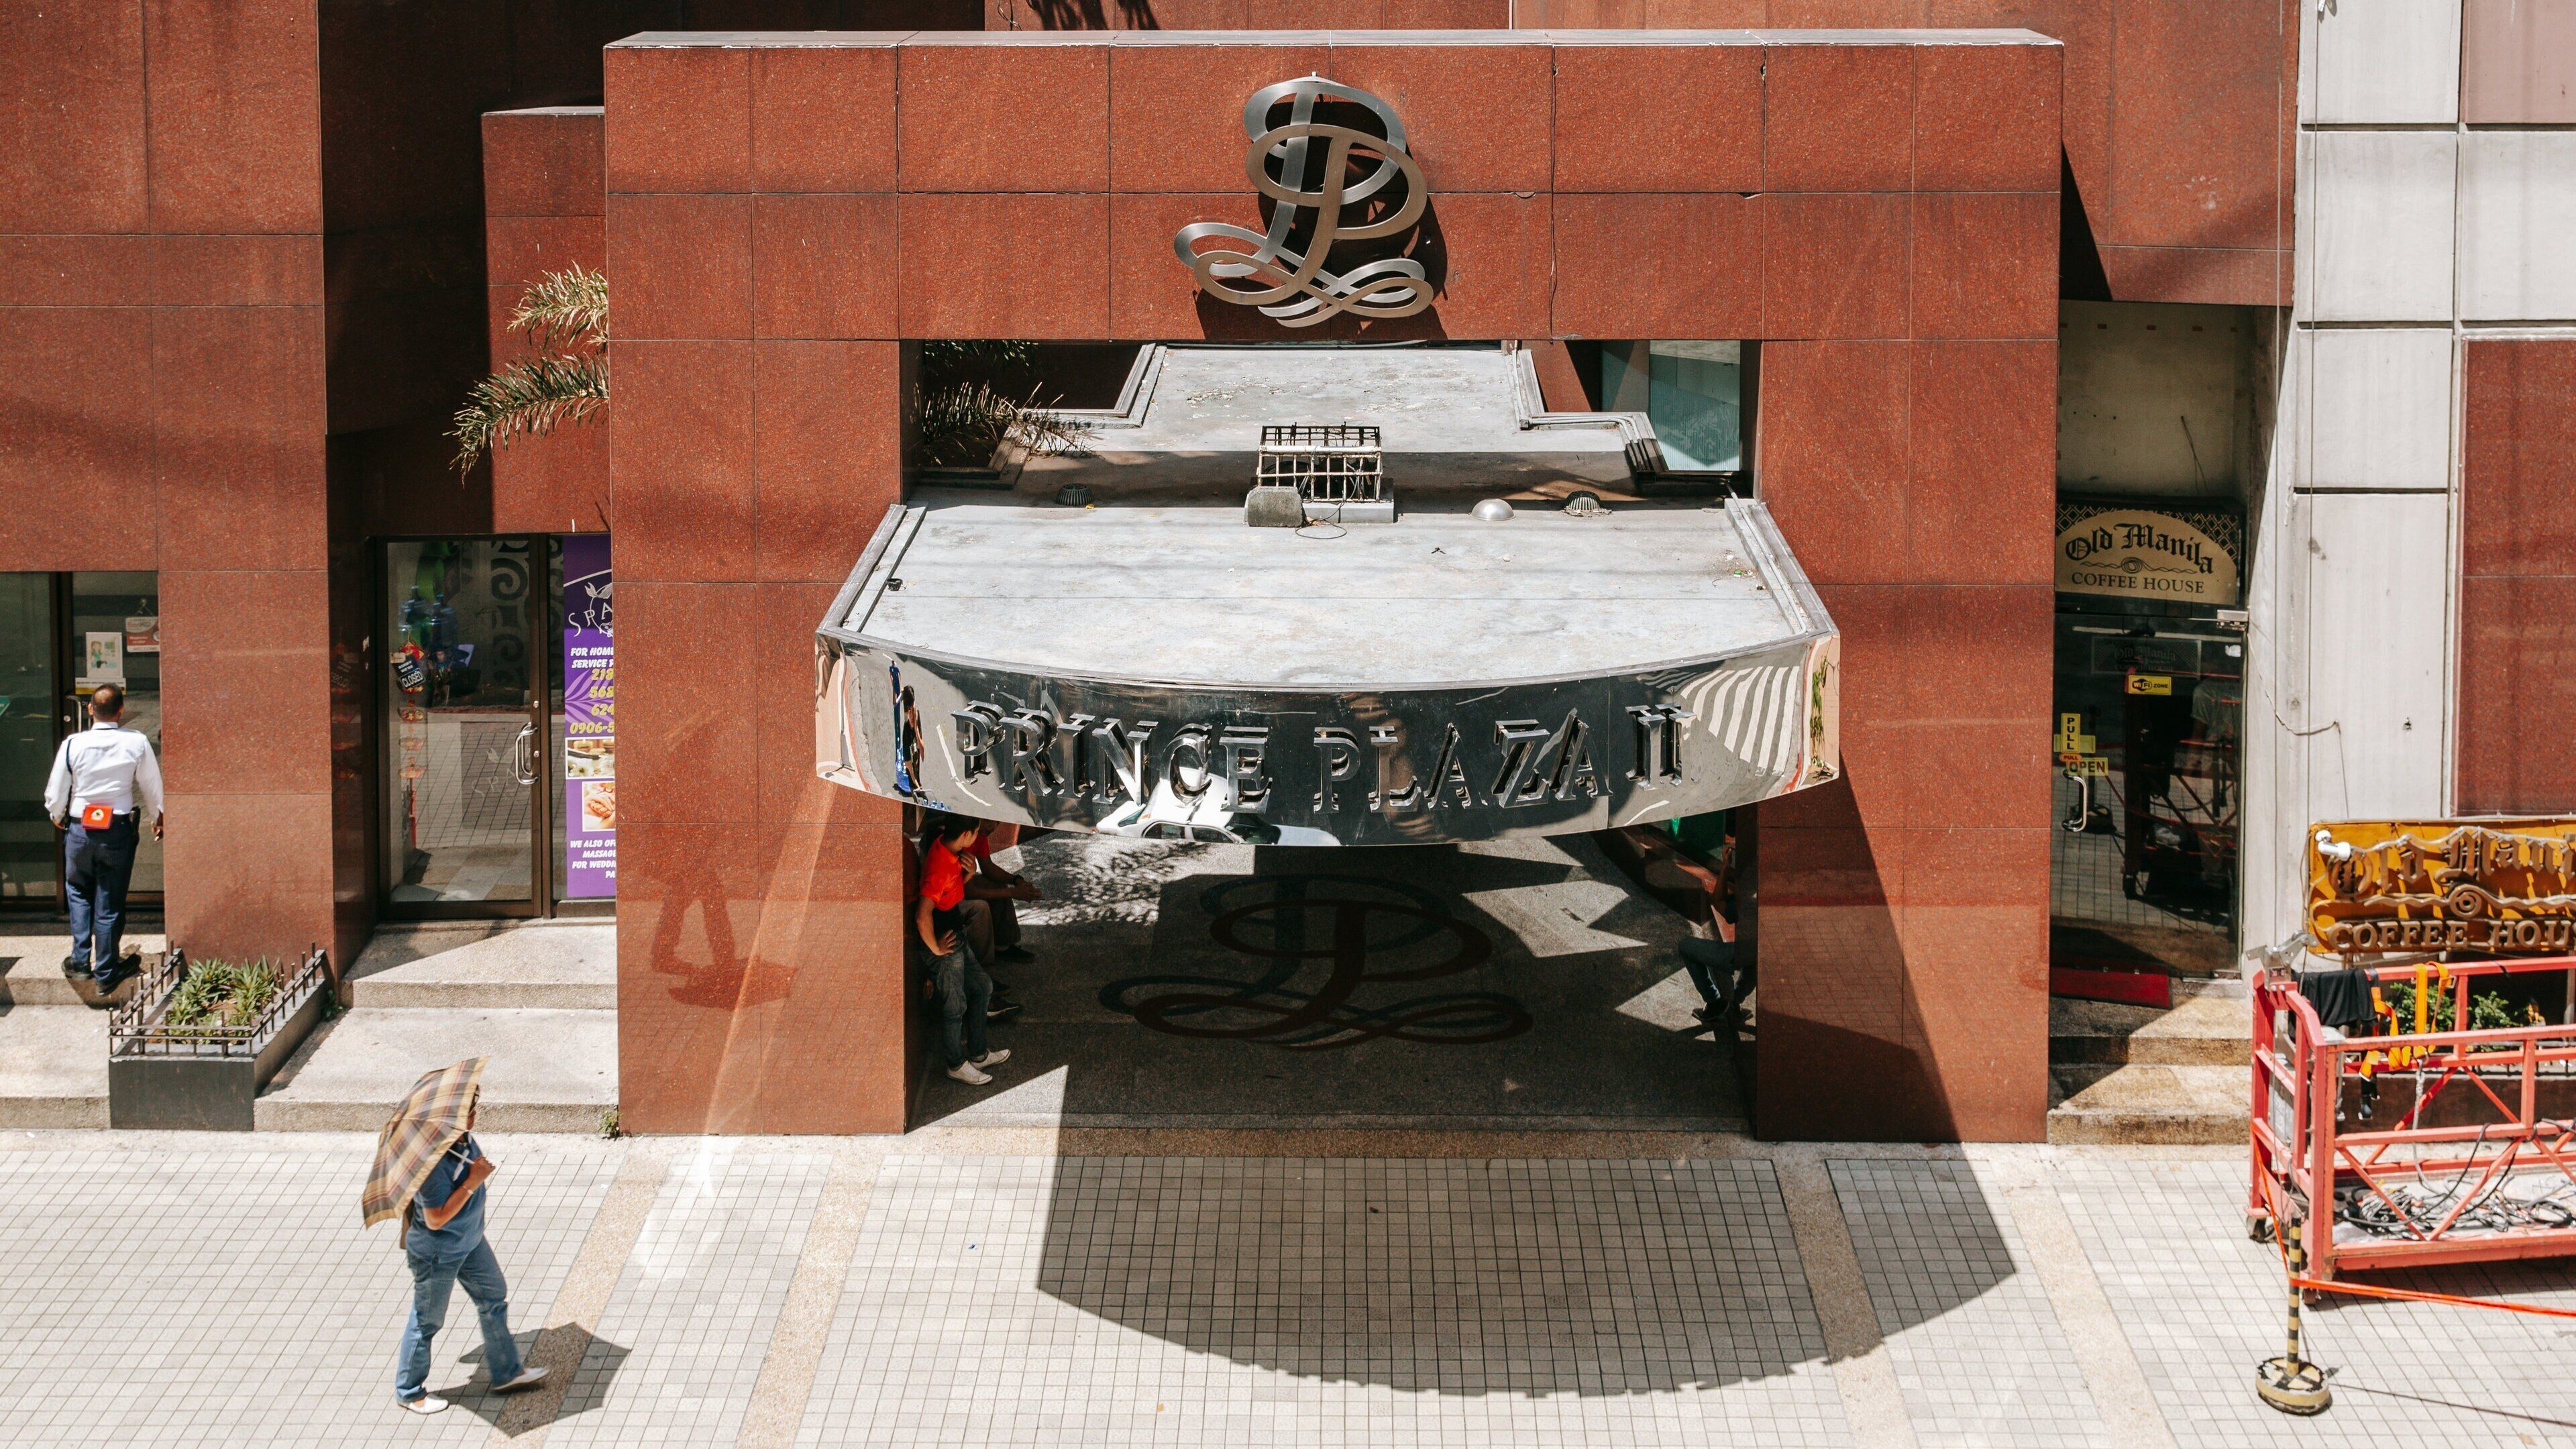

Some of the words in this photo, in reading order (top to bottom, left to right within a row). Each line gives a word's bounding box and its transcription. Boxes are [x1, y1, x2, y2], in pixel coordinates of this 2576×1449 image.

[2065, 527, 2113, 561] Old
[2114, 523, 2213, 574] Manila
[2072, 572, 2137, 588] COFFEE
[2143, 577, 2204, 594] HOUSE
[570, 647, 588, 656] FOR
[572, 659, 607, 668] SERVICE
[402, 671, 423, 688] CLOSED
[2067, 717, 2075, 750] PULL
[951, 701, 1272, 814] PRINCE
[1313, 708, 1613, 813] PLAZA
[1625, 702, 1697, 791] II
[2069, 761, 2106, 773] OPEN
[583, 840, 603, 848] ALSO
[572, 861, 588, 869] FOR
[2327, 839, 2428, 898] Old
[2327, 920, 2468, 949] COFFEE
[2487, 919, 2576, 948] HOU
